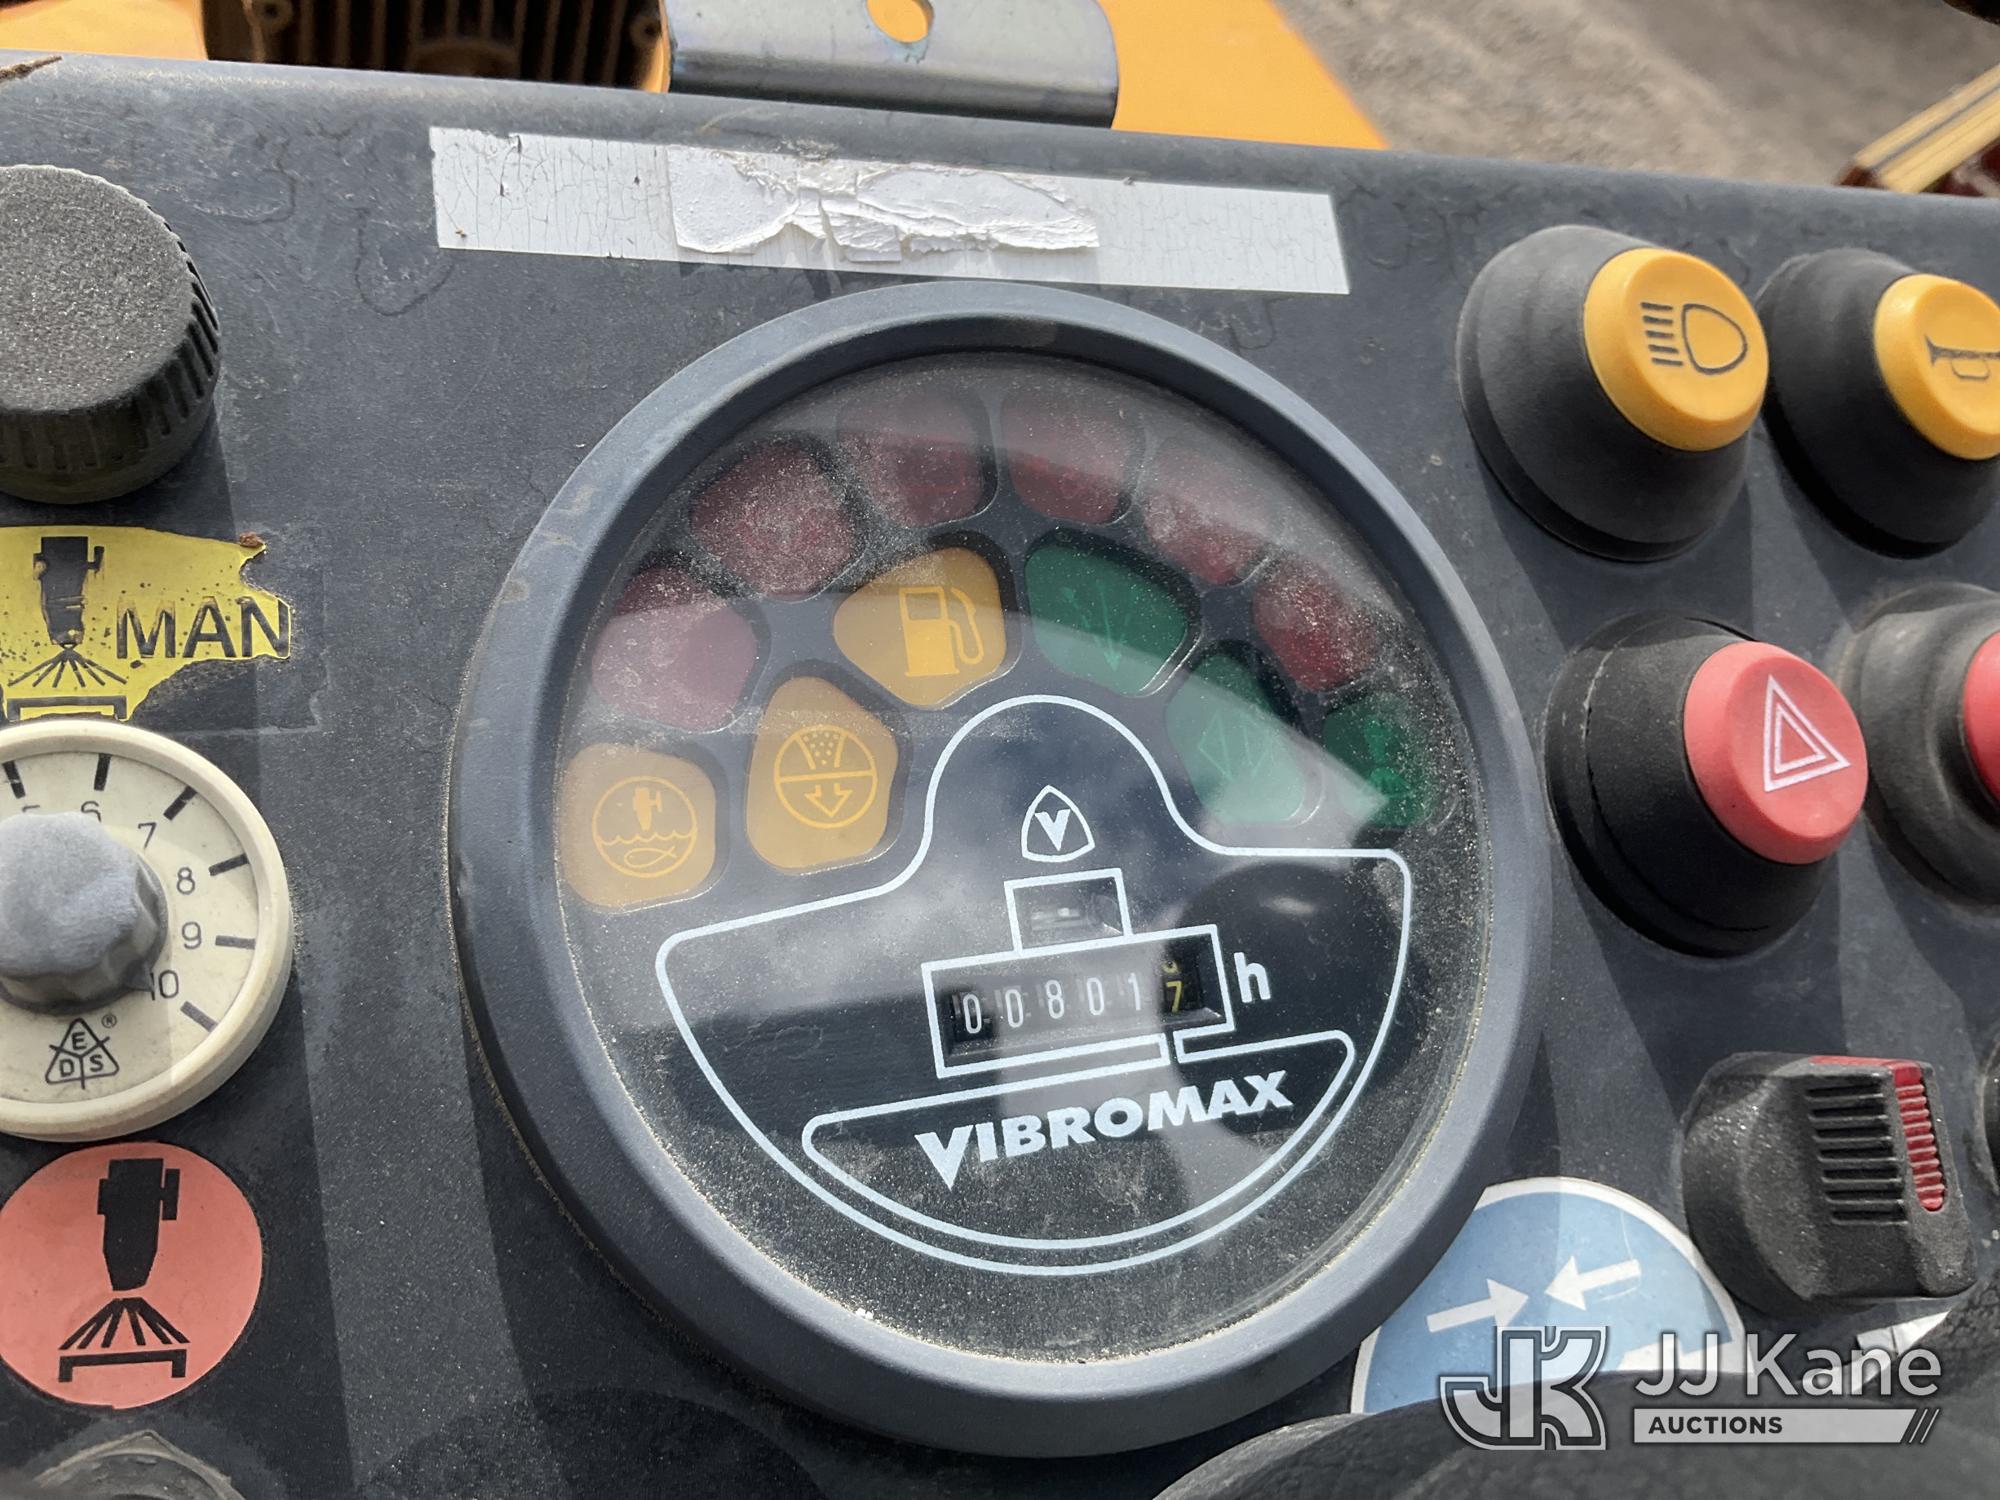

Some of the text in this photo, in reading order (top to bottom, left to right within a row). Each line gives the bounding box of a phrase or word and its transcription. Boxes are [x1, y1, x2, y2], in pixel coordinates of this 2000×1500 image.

[116, 596, 291, 658] MAN
[137, 821, 157, 848] 7
[176, 866, 196, 895] 8
[181, 921, 202, 950] 9
[1233, 951, 1272, 1003] h
[914, 1069, 1294, 1190] VIBROMAX
